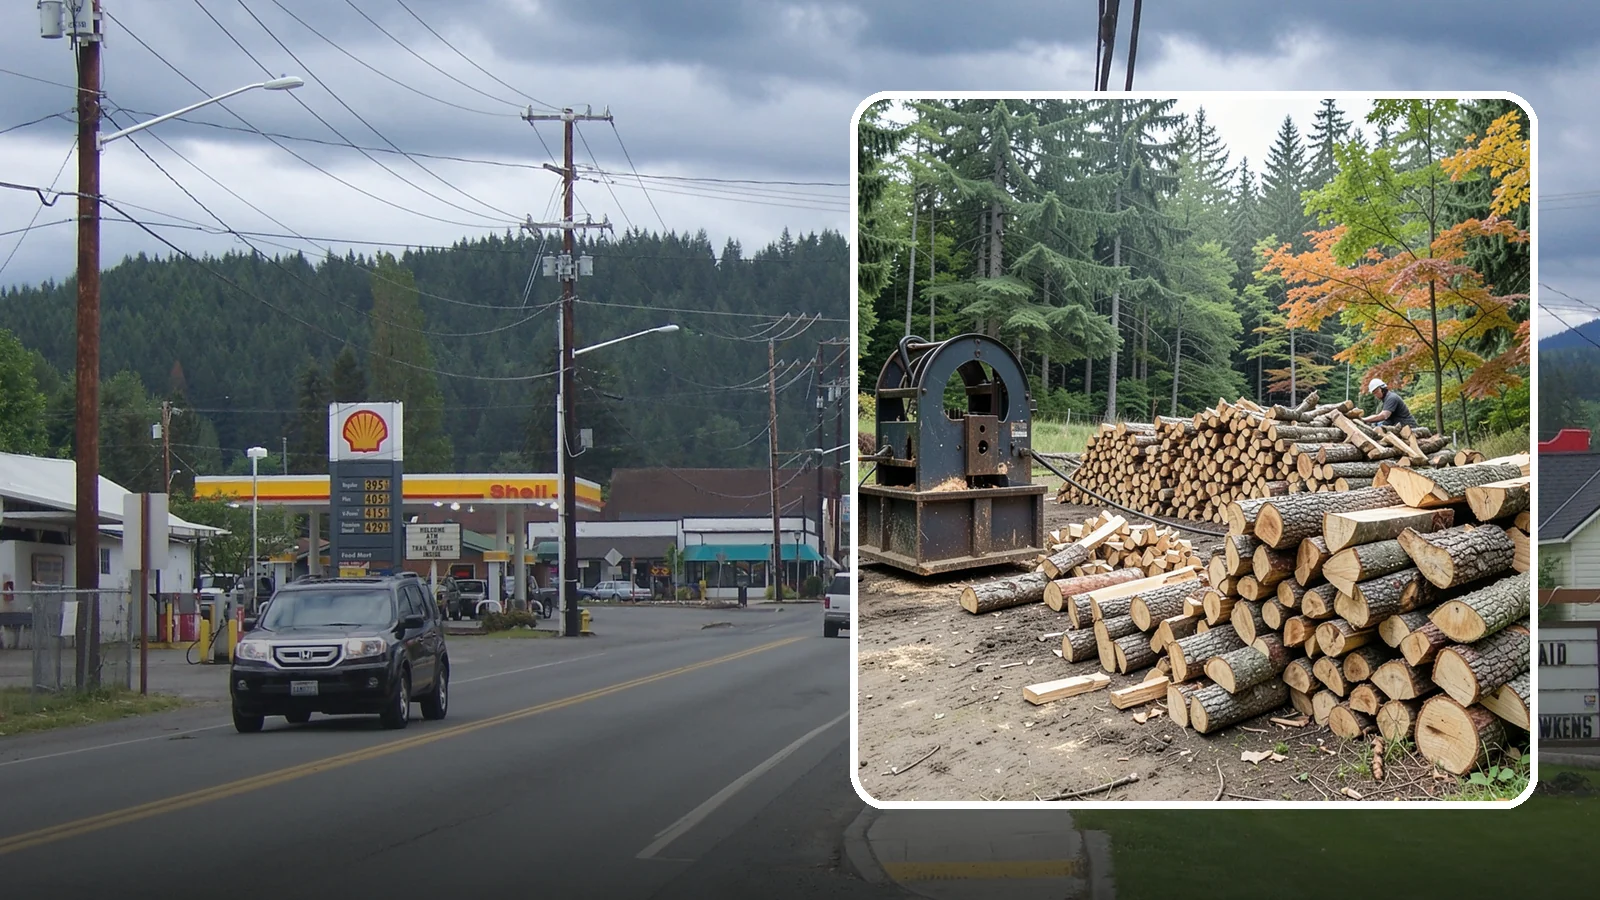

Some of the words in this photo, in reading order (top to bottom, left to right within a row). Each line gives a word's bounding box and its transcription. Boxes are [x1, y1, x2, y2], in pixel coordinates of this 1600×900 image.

[366, 479, 384, 490] 395
[490, 484, 547, 499] Shell
[366, 494, 384, 504] 405
[366, 508, 384, 518] 415
[366, 522, 384, 532] 429
